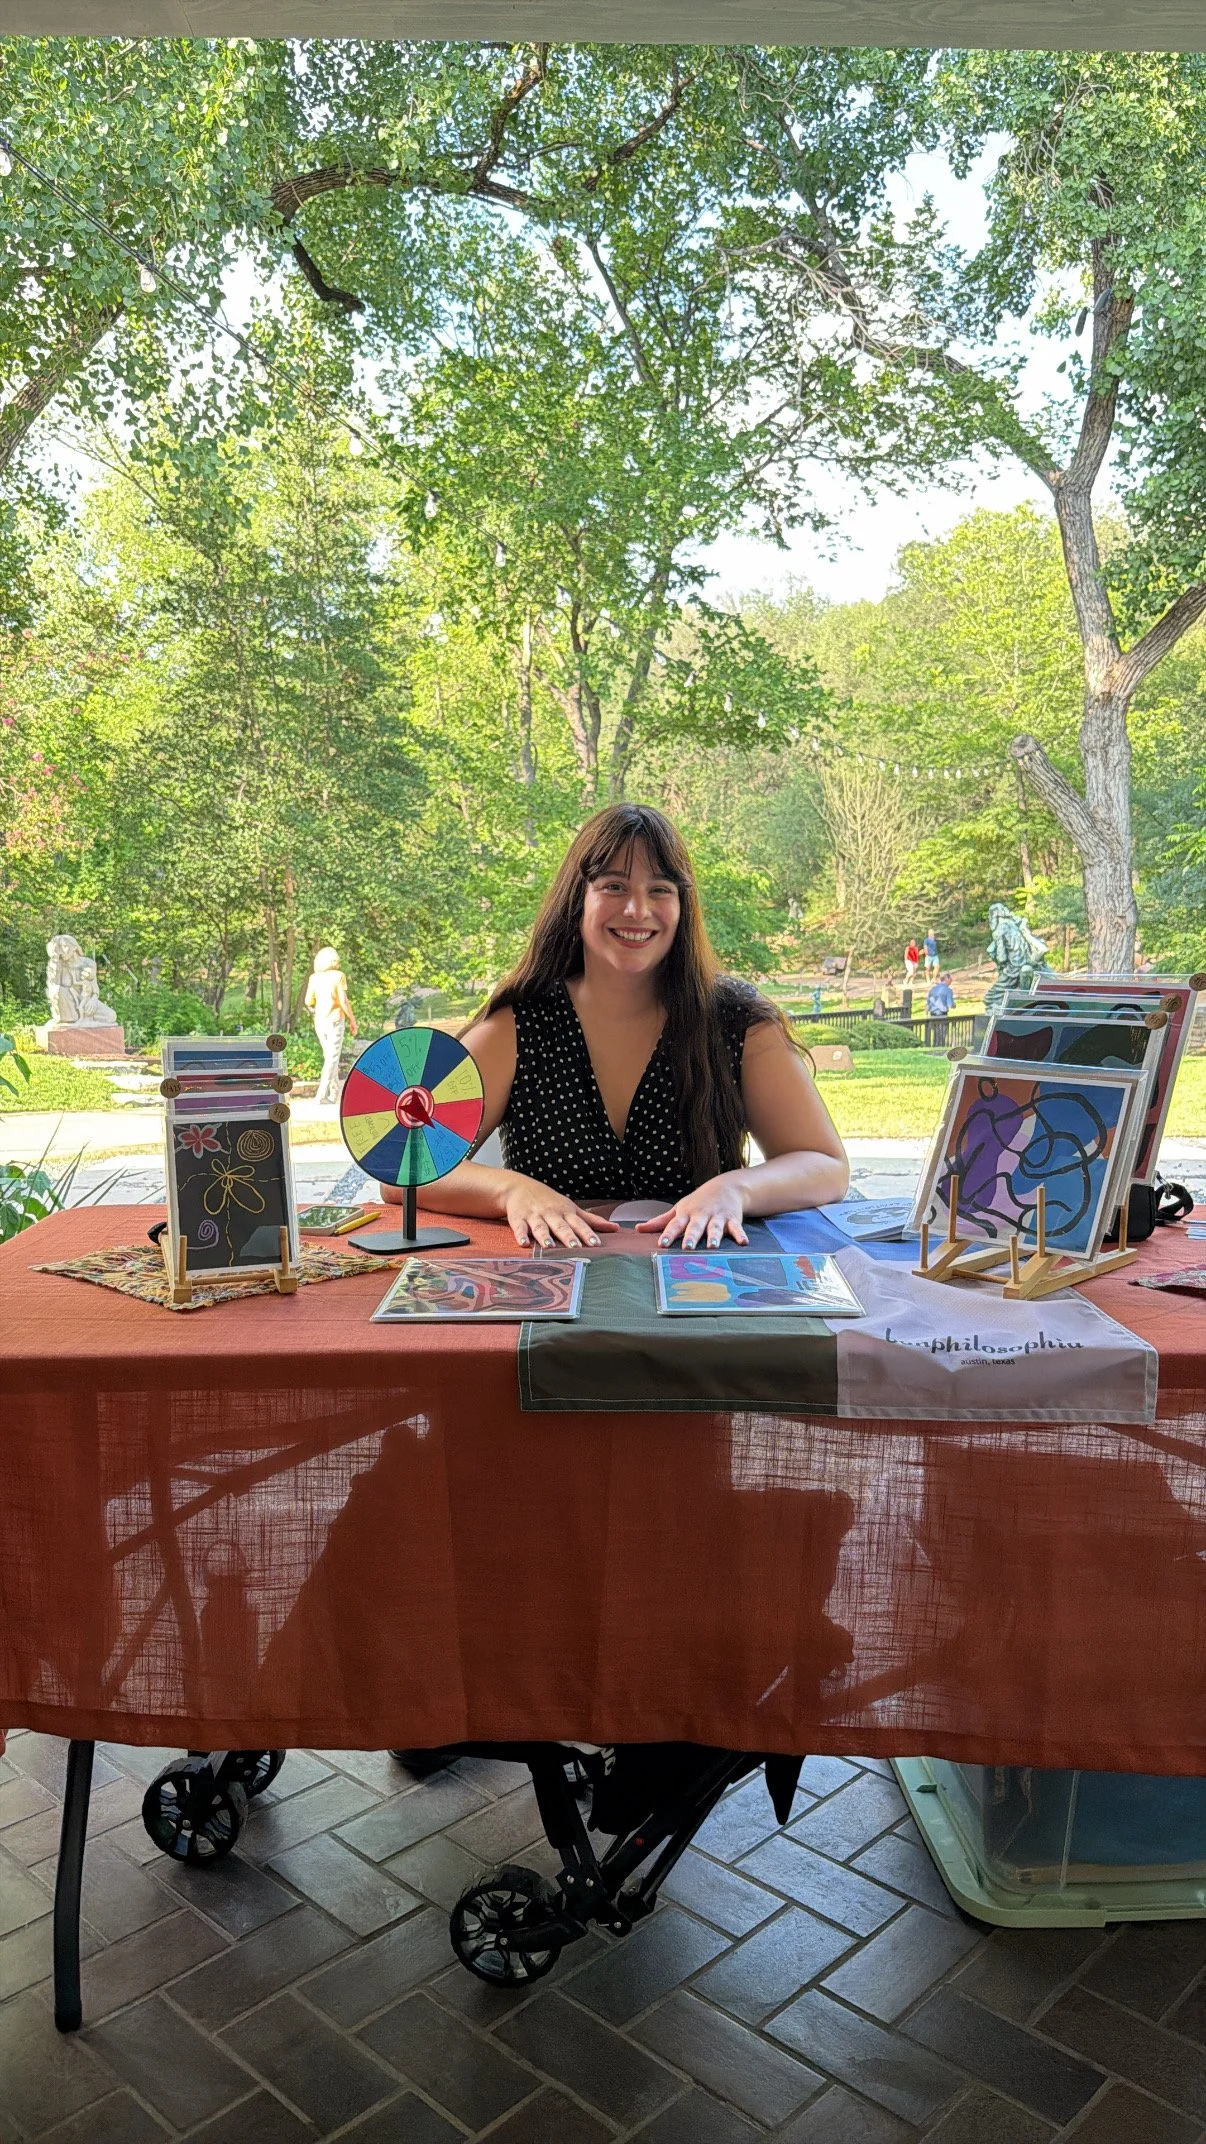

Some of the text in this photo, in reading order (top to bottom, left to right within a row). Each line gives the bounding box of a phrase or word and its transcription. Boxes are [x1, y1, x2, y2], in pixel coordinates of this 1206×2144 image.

[399, 1034, 422, 1058] 5%
[960, 1358, 1016, 1366] austin, texas
